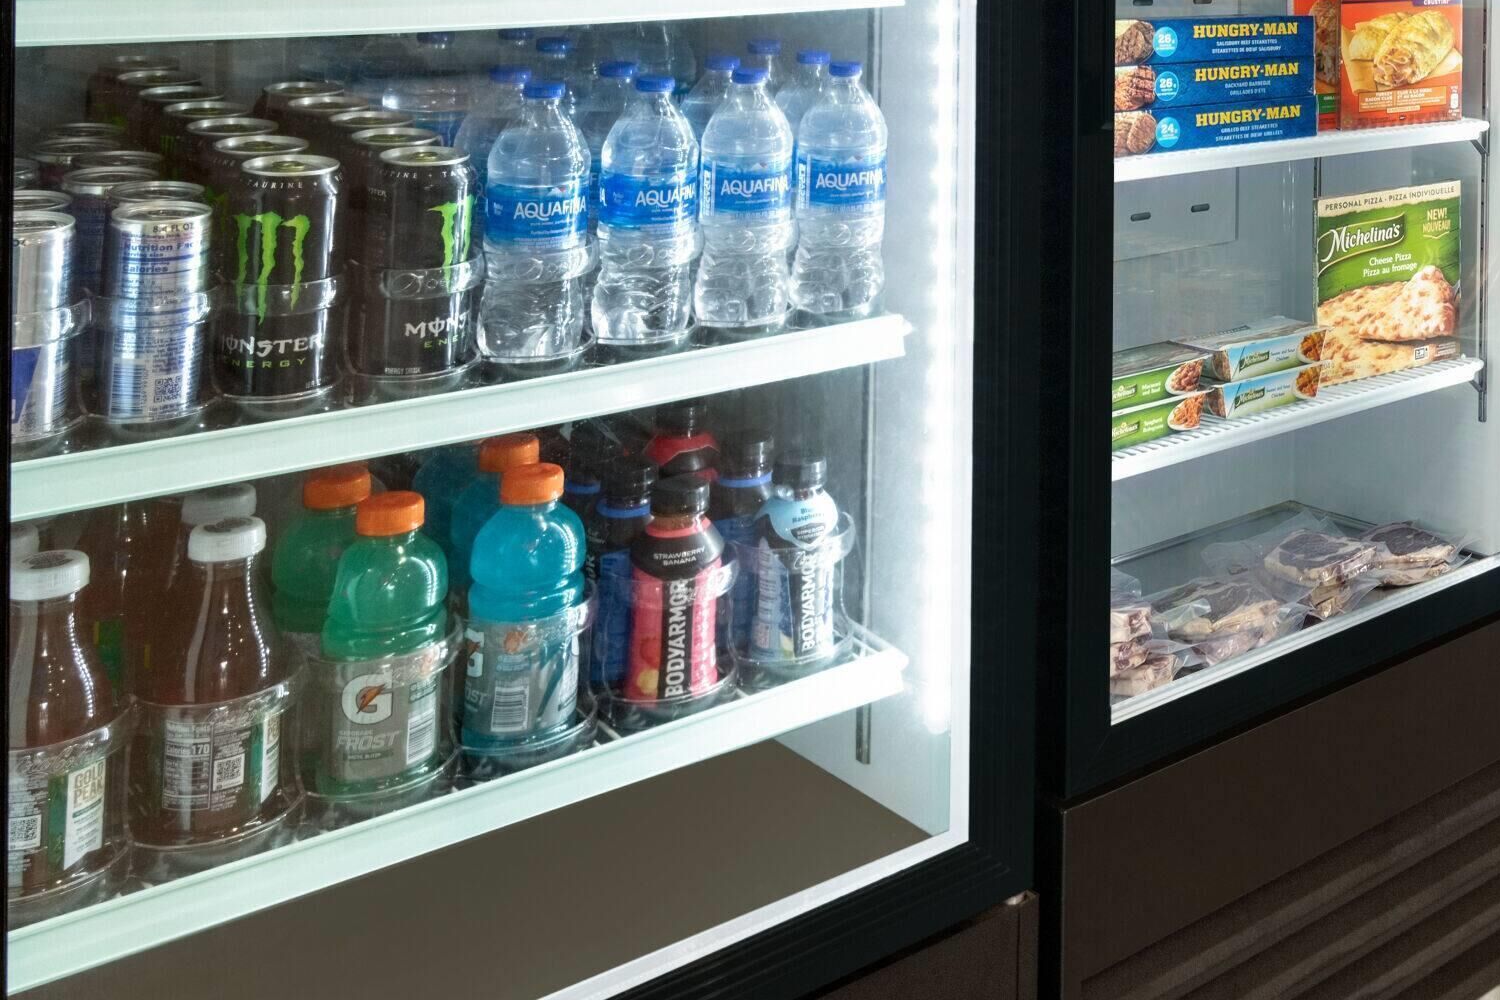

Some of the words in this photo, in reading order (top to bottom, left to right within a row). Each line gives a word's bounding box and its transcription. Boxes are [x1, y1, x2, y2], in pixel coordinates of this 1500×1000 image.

[1193, 22, 1299, 39] HUNGRY-MAN
[1195, 62, 1299, 82] HUNGRY-MAN
[1196, 104, 1302, 127] HUNGRY-MAN
[1160, 123, 1174, 135] 24
[248, 180, 303, 189] TAURINE
[720, 175, 790, 197] AQUAFINA
[815, 168, 883, 190] AQUAFINA
[635, 183, 696, 207] AQUAFINA
[1325, 200, 1362, 211] PERSONAL
[1363, 197, 1383, 206] PIZZA
[1388, 193, 1408, 201] PIZZA
[1409, 185, 1455, 200] INDIVIDUELLE
[513, 196, 587, 221] AQUAFINA
[1426, 207, 1448, 221] NEW!
[171, 223, 179, 232] FL
[1422, 219, 1451, 233] NOUVEAU!
[1320, 223, 1401, 262] Michelina's
[1369, 255, 1393, 266] Cheese
[1395, 252, 1411, 262] Pizza
[123, 264, 169, 273] Calories
[1363, 267, 1380, 278] Pizza
[1382, 266, 1390, 274] au
[1391, 261, 1418, 273] fromage
[223, 357, 306, 369] NERGY
[1112, 385, 1136, 400] ichelina's
[1112, 422, 1138, 437] ichelina's
[653, 547, 706, 560] STRAWBERRY
[663, 557, 697, 566] BANANA
[801, 551, 820, 652] BODYARMOR
[664, 577, 690, 698] BODYARMOR
[341, 673, 393, 725] G
[192, 743, 210, 755] 170
[336, 730, 400, 752] FROST
[74, 761, 105, 789] GOLD
